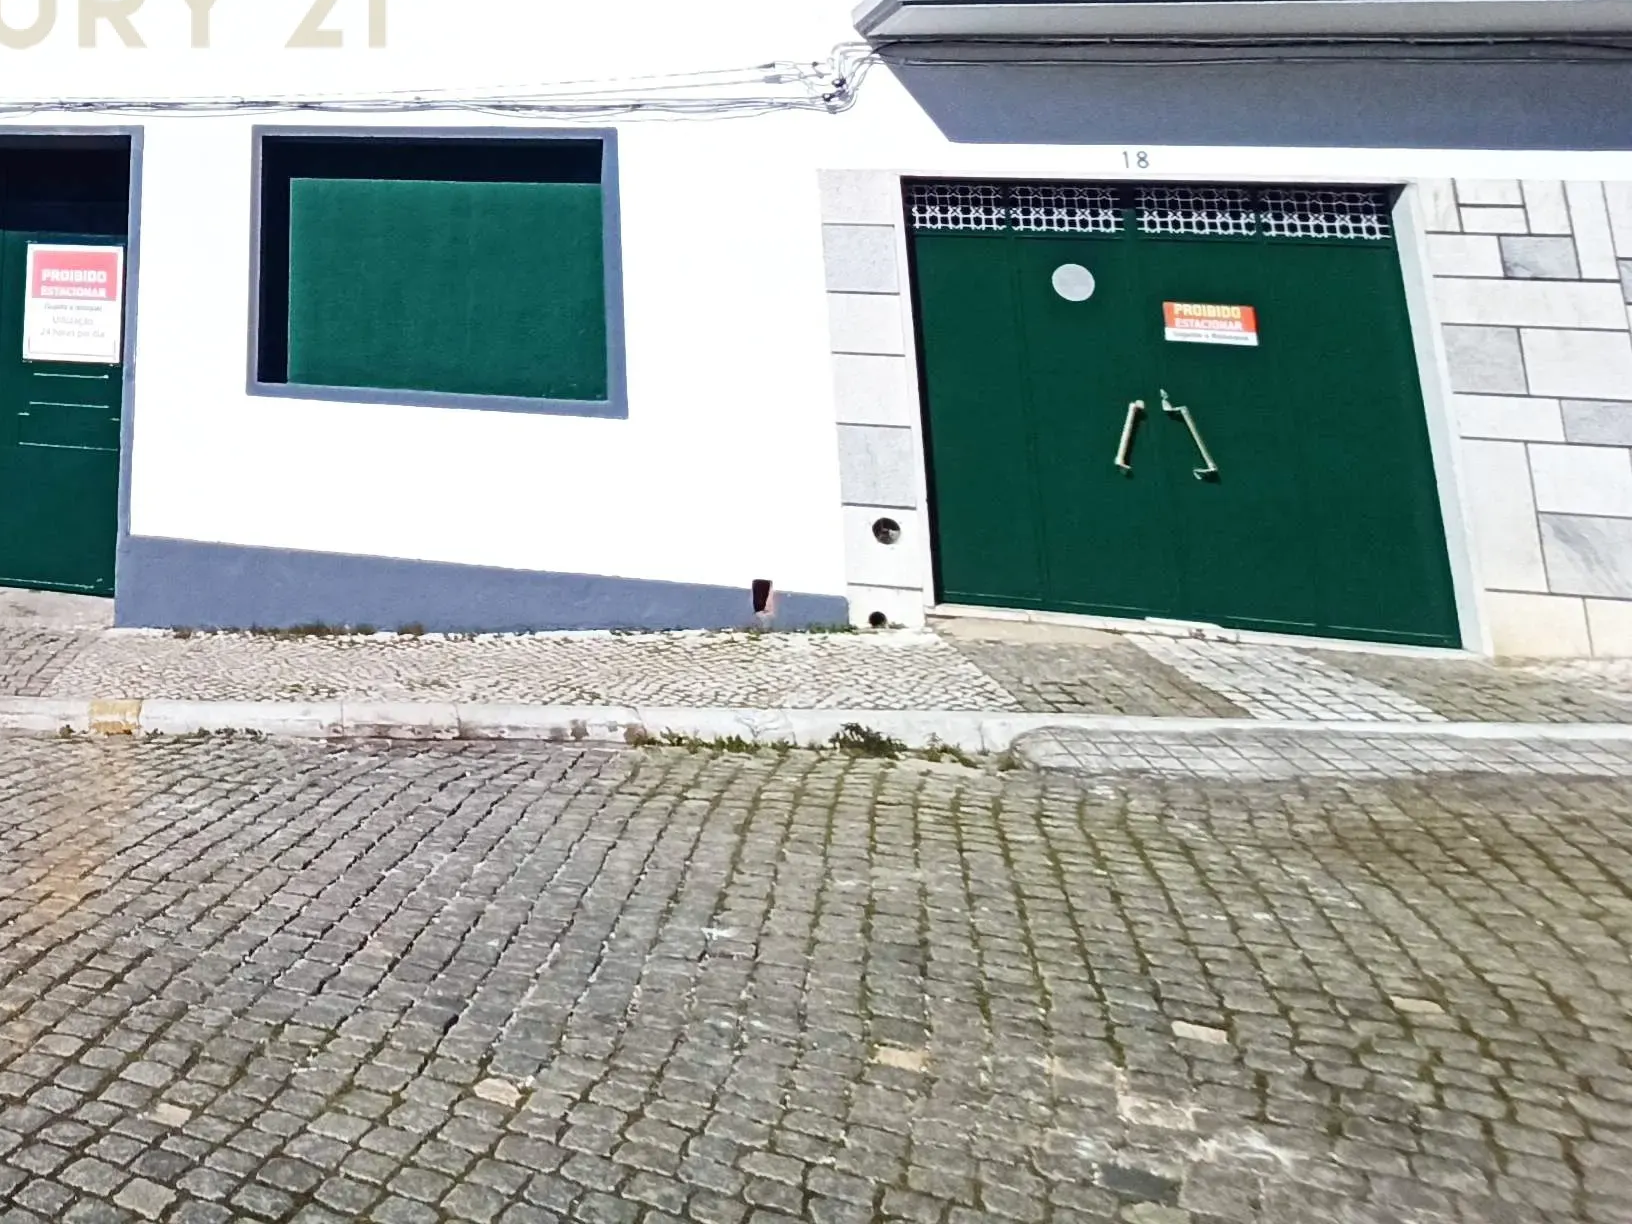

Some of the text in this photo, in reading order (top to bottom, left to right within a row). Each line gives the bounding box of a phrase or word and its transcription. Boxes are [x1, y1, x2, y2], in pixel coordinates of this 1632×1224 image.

[1122, 150, 1150, 169] 18
[41, 268, 107, 283] PROIBIDO
[40, 284, 107, 298] ESTACIONAR
[1173, 303, 1241, 319] PROIBIDO
[1173, 317, 1243, 332] ESTACIONAR
